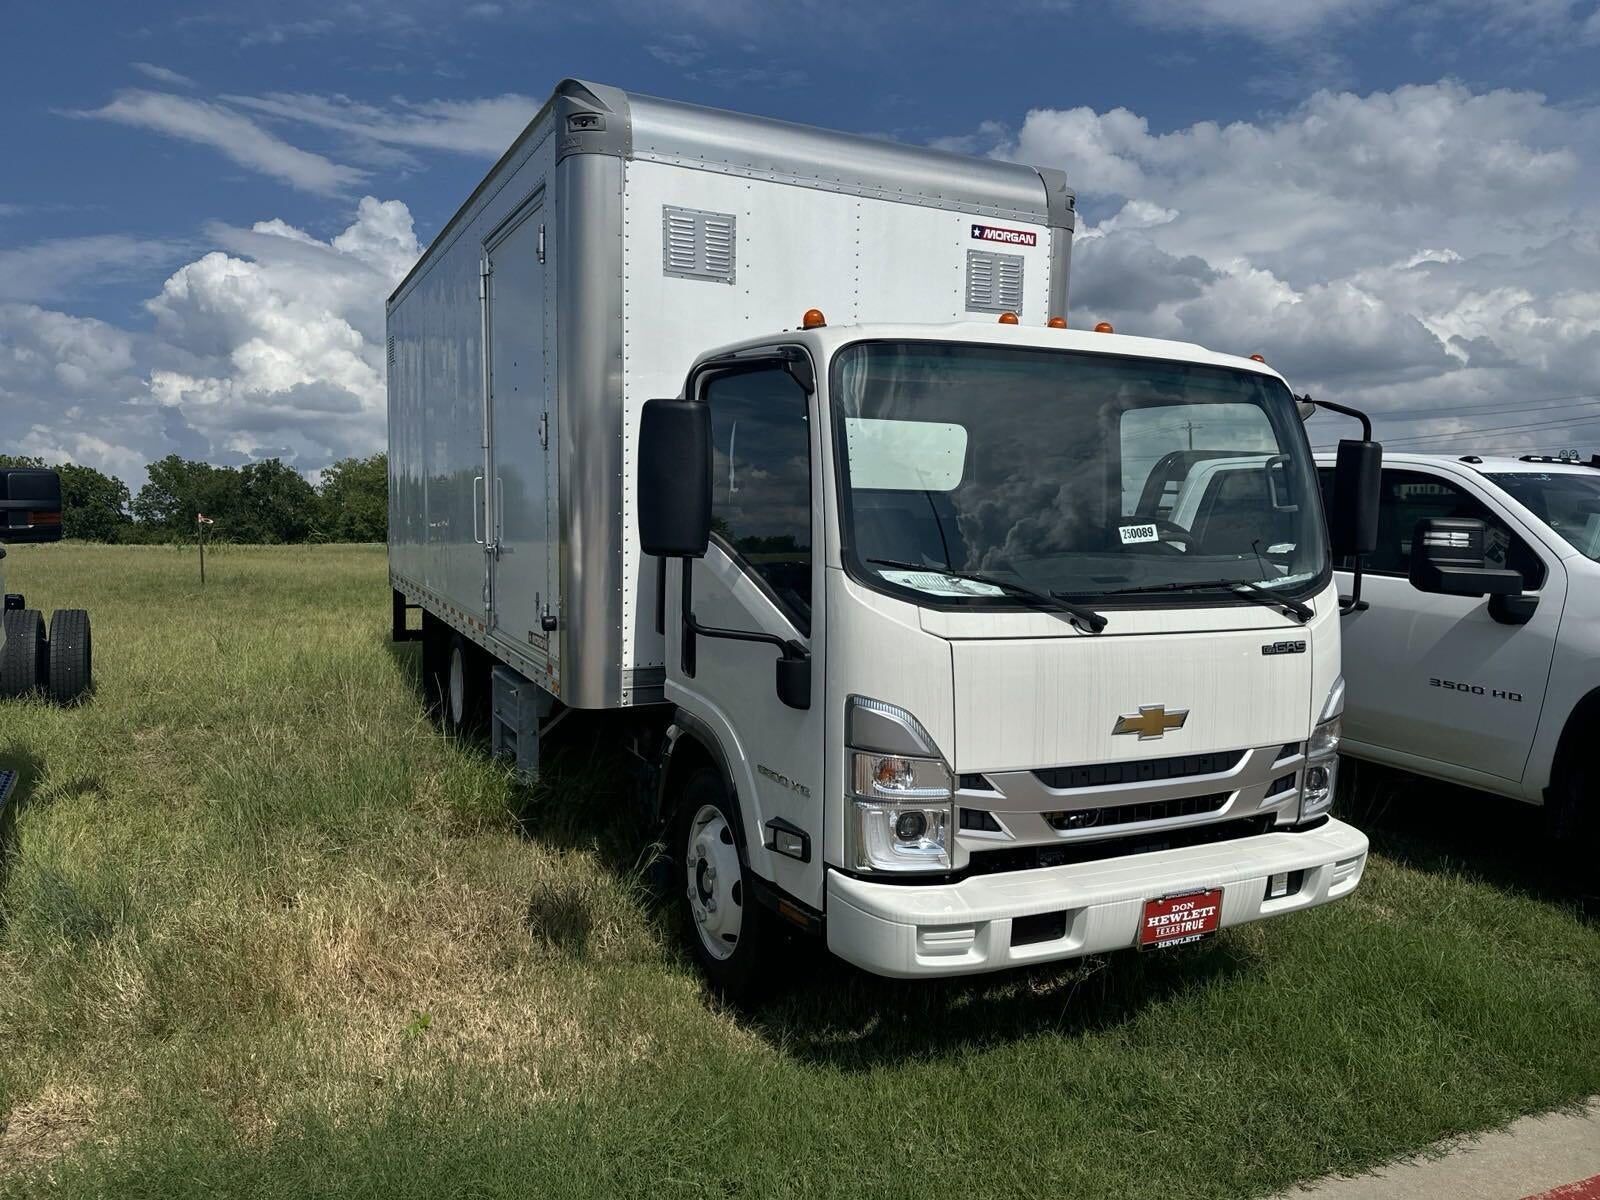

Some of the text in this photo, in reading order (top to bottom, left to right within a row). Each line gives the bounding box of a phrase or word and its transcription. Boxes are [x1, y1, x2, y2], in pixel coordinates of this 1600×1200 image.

[983, 229, 1035, 244] MORGAN
[1122, 526, 1154, 540] 250089
[1429, 677, 1522, 702] 3500 HD
[1171, 901, 1195, 913] DON
[1147, 906, 1216, 928] HEWLETT
[1157, 935, 1202, 949] HEWLETT
